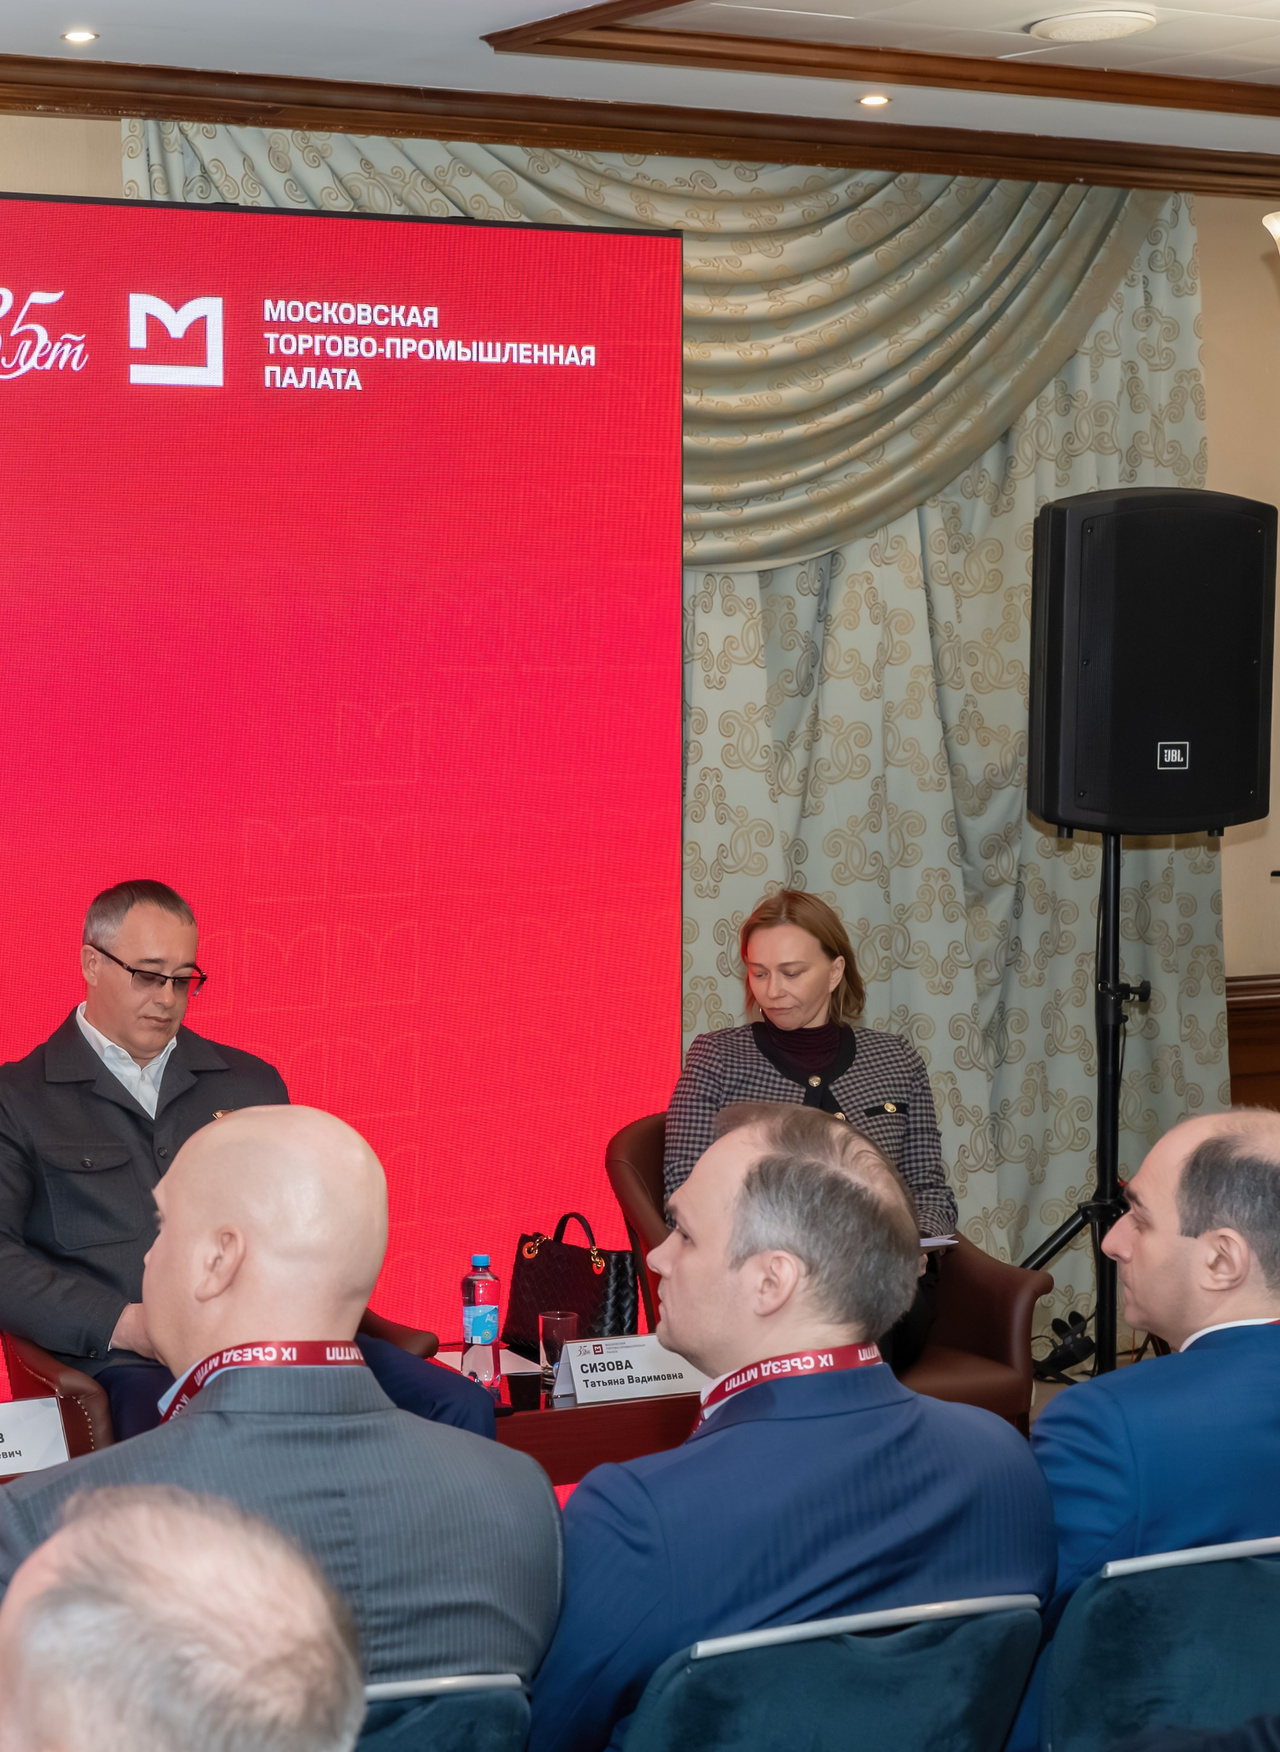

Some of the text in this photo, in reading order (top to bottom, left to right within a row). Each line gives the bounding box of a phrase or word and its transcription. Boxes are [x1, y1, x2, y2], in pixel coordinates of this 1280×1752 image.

[263, 299, 439, 328] МОСКОВСКАЯ
[263, 332, 596, 367] ТОРГОВО-ПРОМЫШЛЕННАЯ
[264, 365, 363, 391] ПАЛАТА
[1163, 749, 1184, 763] JBL
[222, 1346, 278, 1365] СЪЕЗД
[281, 1348, 297, 1362] IX
[580, 1359, 634, 1374] СИЗОВА
[724, 1353, 834, 1392] IX СЪЕЗД МТПП
[583, 1372, 684, 1389] Татьяна Вадимовна
